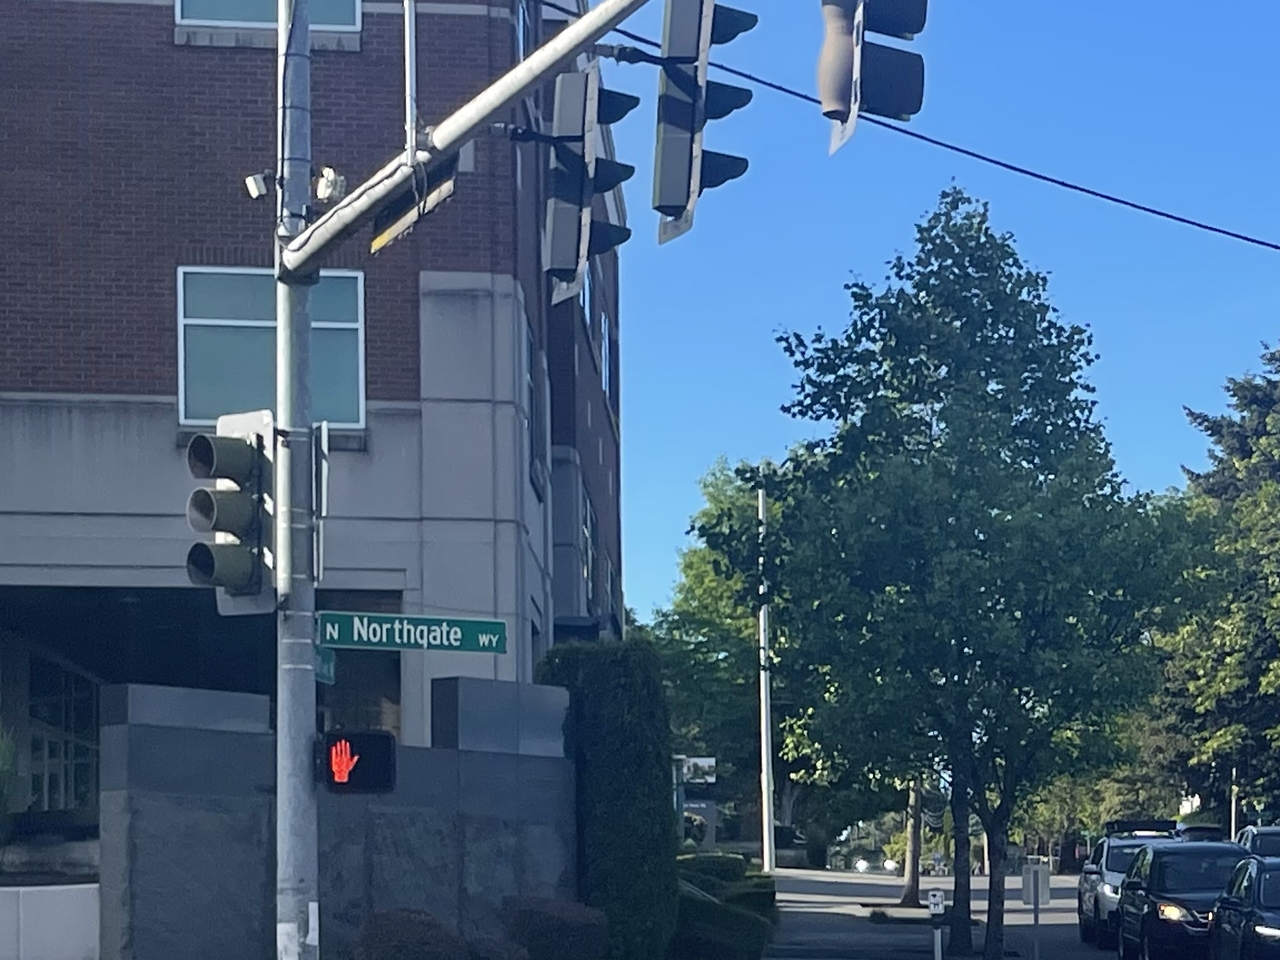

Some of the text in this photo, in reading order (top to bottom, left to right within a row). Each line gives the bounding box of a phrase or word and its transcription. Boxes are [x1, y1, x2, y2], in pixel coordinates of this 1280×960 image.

[326, 616, 499, 650] N Northgate WY
